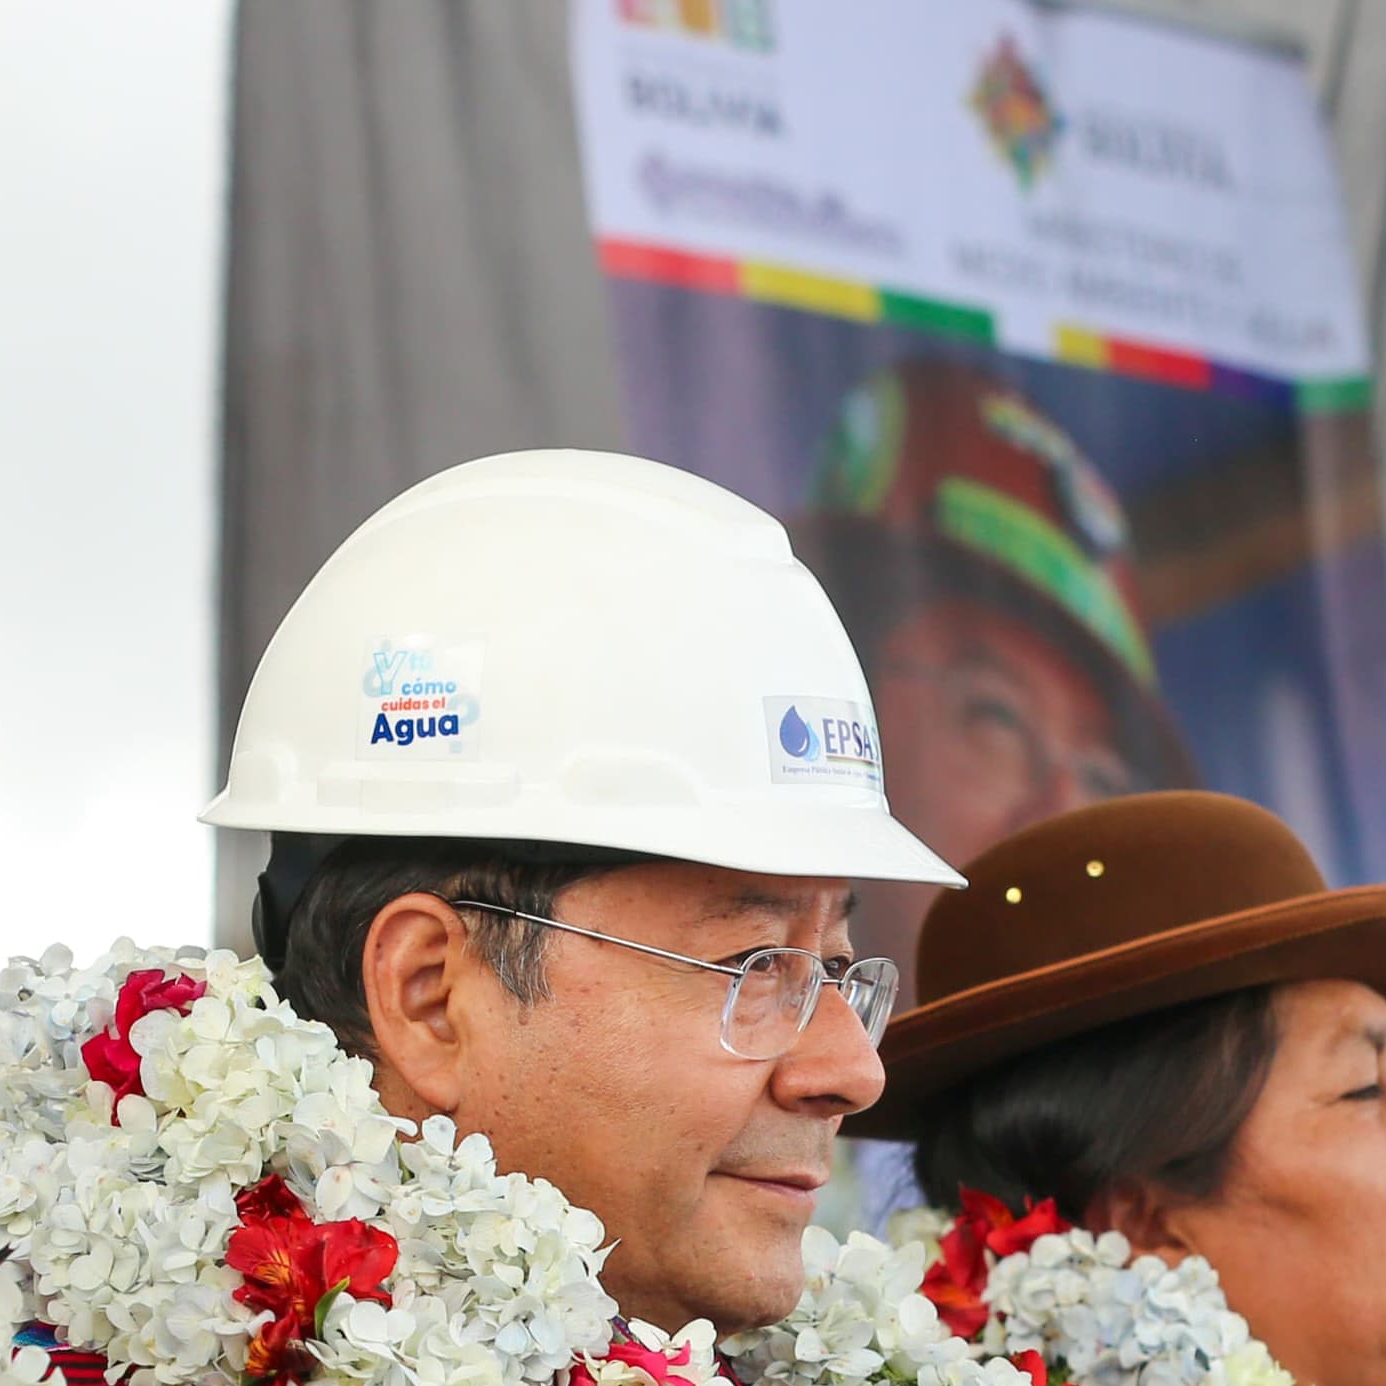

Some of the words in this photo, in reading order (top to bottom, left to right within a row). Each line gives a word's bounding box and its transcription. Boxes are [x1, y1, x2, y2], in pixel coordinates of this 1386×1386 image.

[401, 677, 457, 695] cómo
[381, 698, 429, 712] cuidas
[432, 697, 446, 710] el
